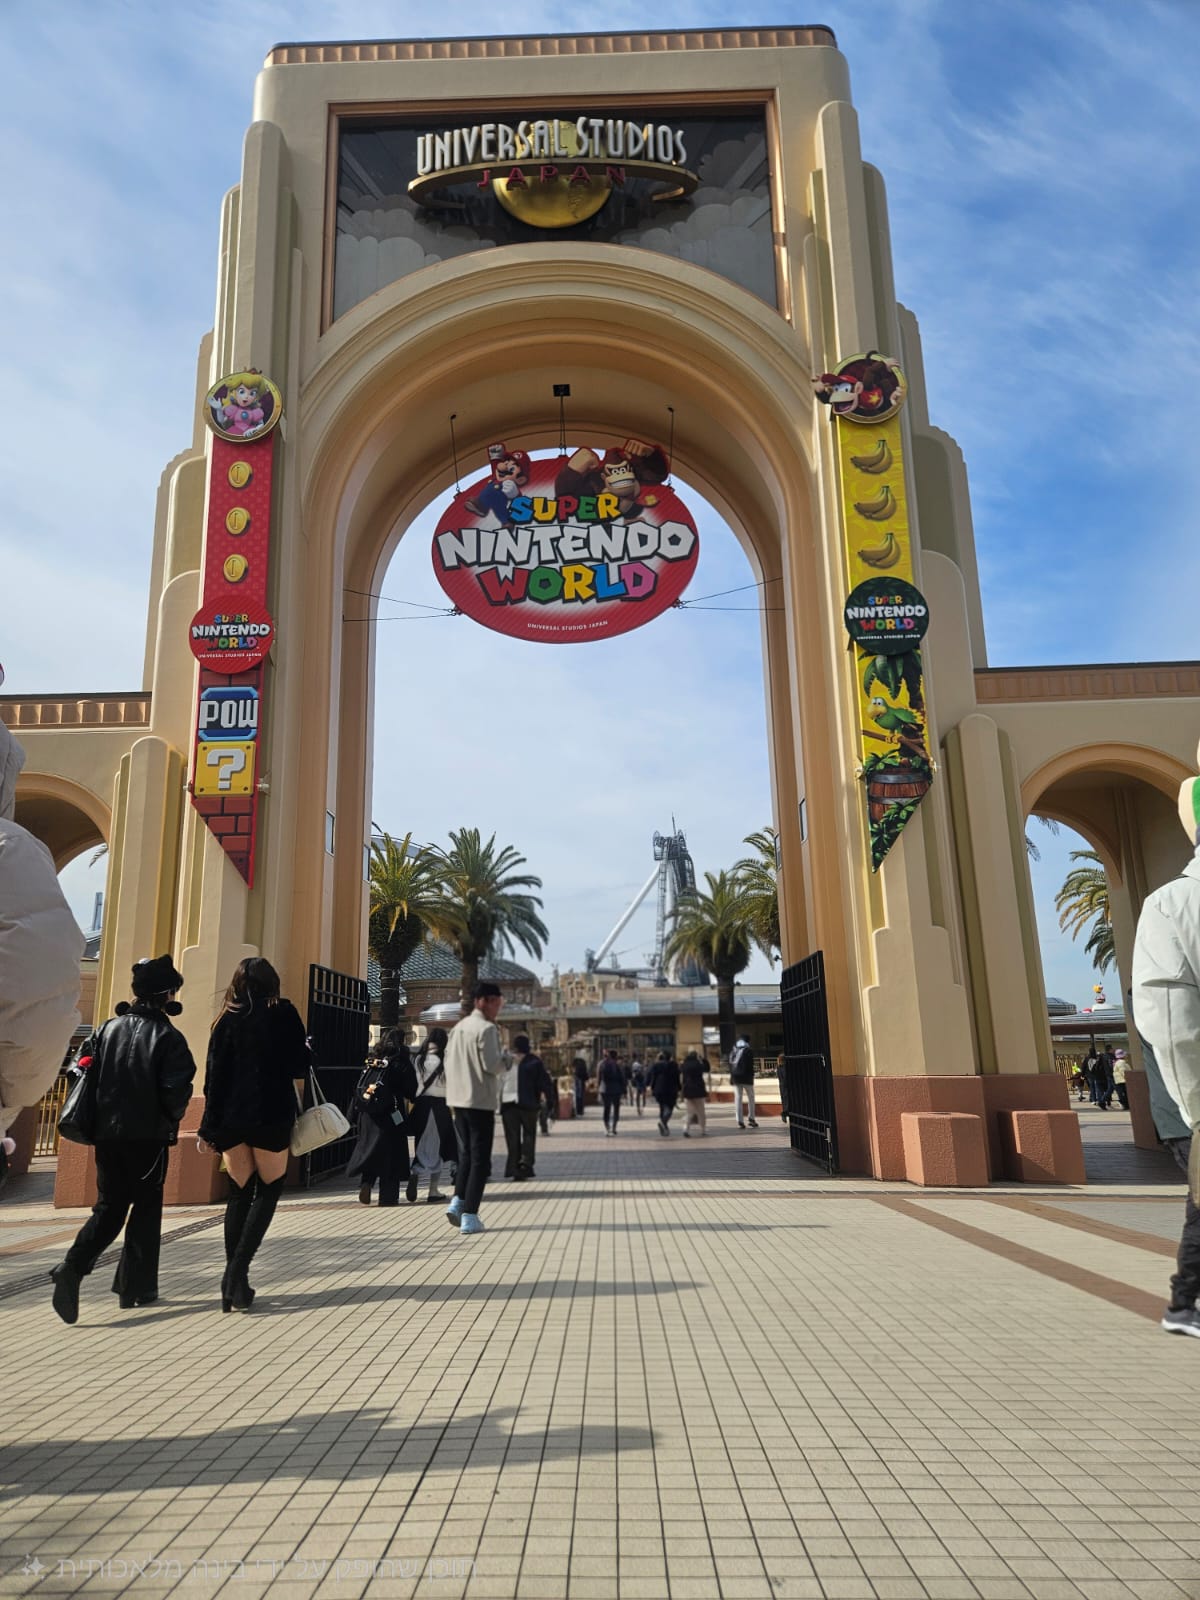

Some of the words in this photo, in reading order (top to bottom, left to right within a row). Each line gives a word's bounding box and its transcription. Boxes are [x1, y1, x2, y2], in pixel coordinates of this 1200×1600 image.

[416, 119, 570, 175] UNIVERSAL
[576, 116, 688, 164] STUDIOS
[476, 165, 626, 189] JAPAN
[510, 492, 621, 524] SUPER
[437, 521, 696, 570] NINTENDO
[476, 562, 658, 605] WORLD
[868, 595, 903, 605] SUPER
[214, 613, 249, 624] SUPER
[846, 604, 927, 620] NINTENDO
[191, 623, 271, 639] NINTENDO
[527, 622, 560, 631] UNIVERSAL
[588, 619, 608, 629] JAPAN
[860, 617, 915, 631] WORLD
[206, 636, 258, 651] WORLD
[198, 699, 259, 729] POW
